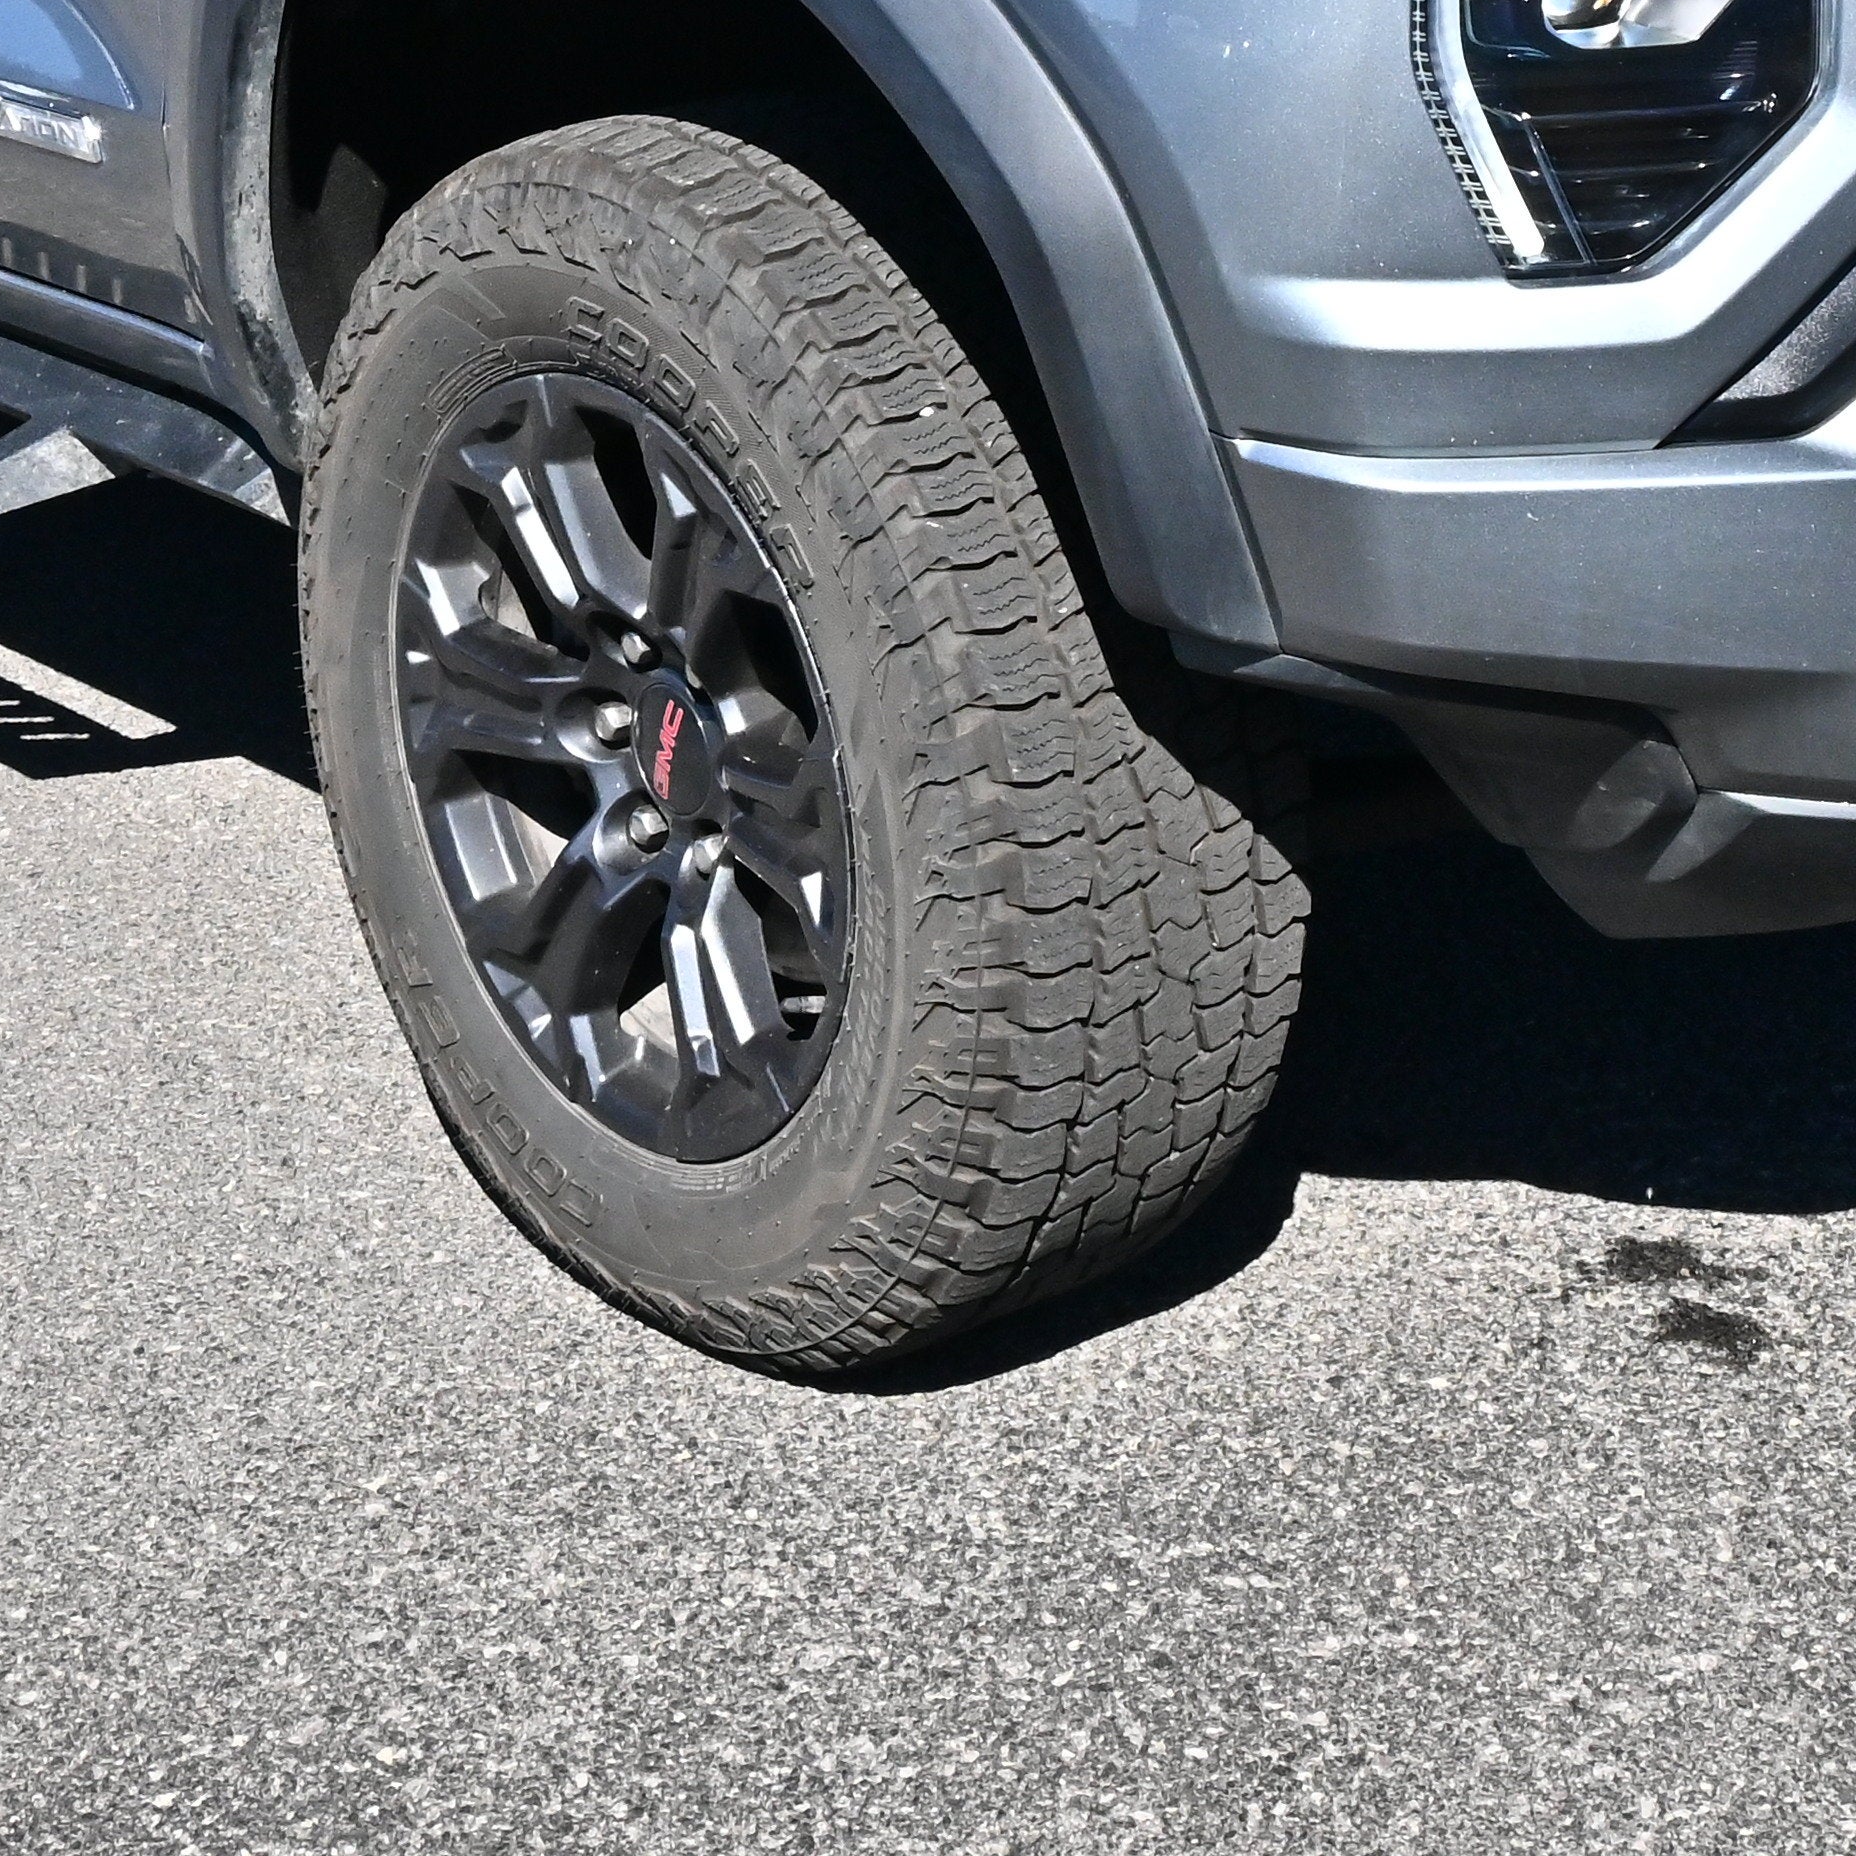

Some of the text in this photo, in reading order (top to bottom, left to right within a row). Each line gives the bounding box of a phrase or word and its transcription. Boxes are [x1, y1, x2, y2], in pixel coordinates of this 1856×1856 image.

[563, 296, 815, 590] COOPER
[653, 699, 684, 799] GMC
[393, 930, 600, 1227] COOPER
